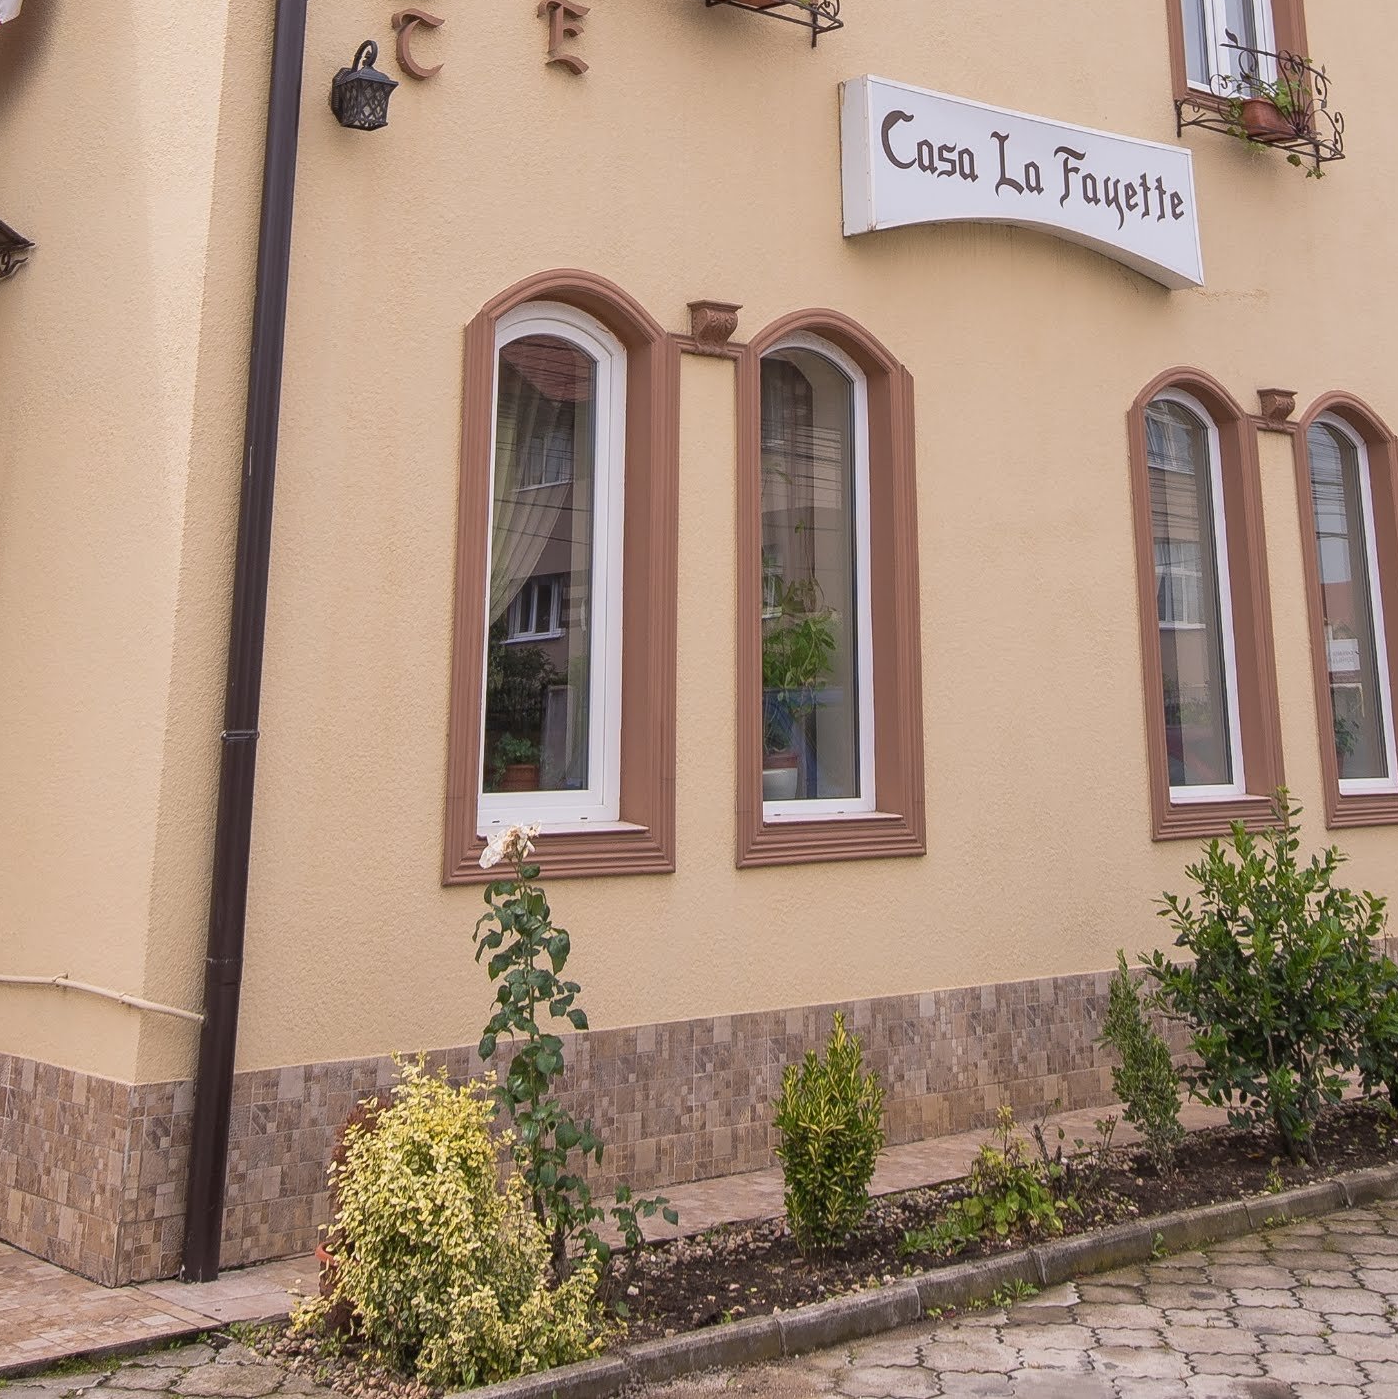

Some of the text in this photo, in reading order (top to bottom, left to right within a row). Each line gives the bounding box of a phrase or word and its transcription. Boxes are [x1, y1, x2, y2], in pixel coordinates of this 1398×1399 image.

[880, 109, 1186, 231] Casa La Fayette
